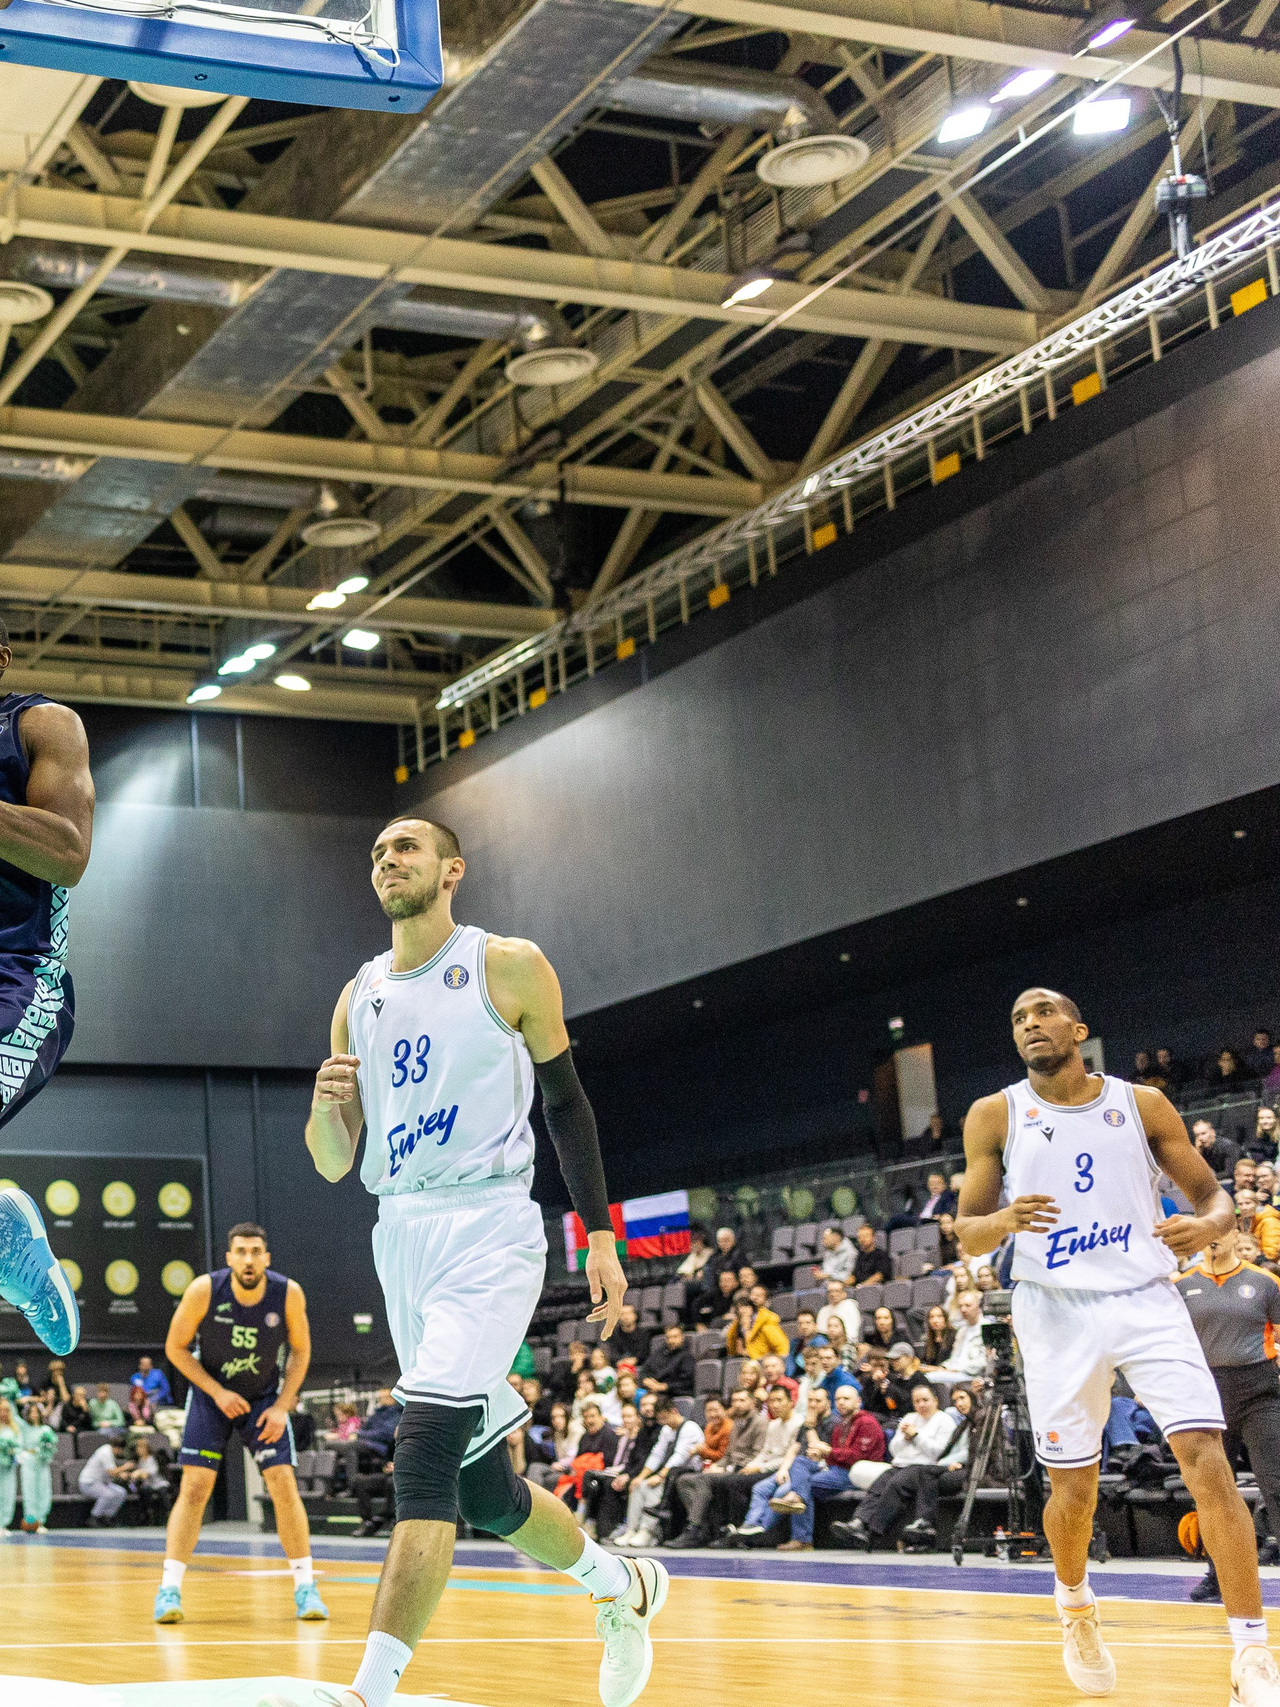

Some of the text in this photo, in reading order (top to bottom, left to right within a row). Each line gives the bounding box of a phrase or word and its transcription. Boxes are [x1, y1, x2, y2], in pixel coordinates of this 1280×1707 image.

[391, 1033, 431, 1088] 33
[1073, 1152, 1095, 1194] 3
[1046, 1221, 1133, 1271] Enisey
[230, 1324, 259, 1350] 55
